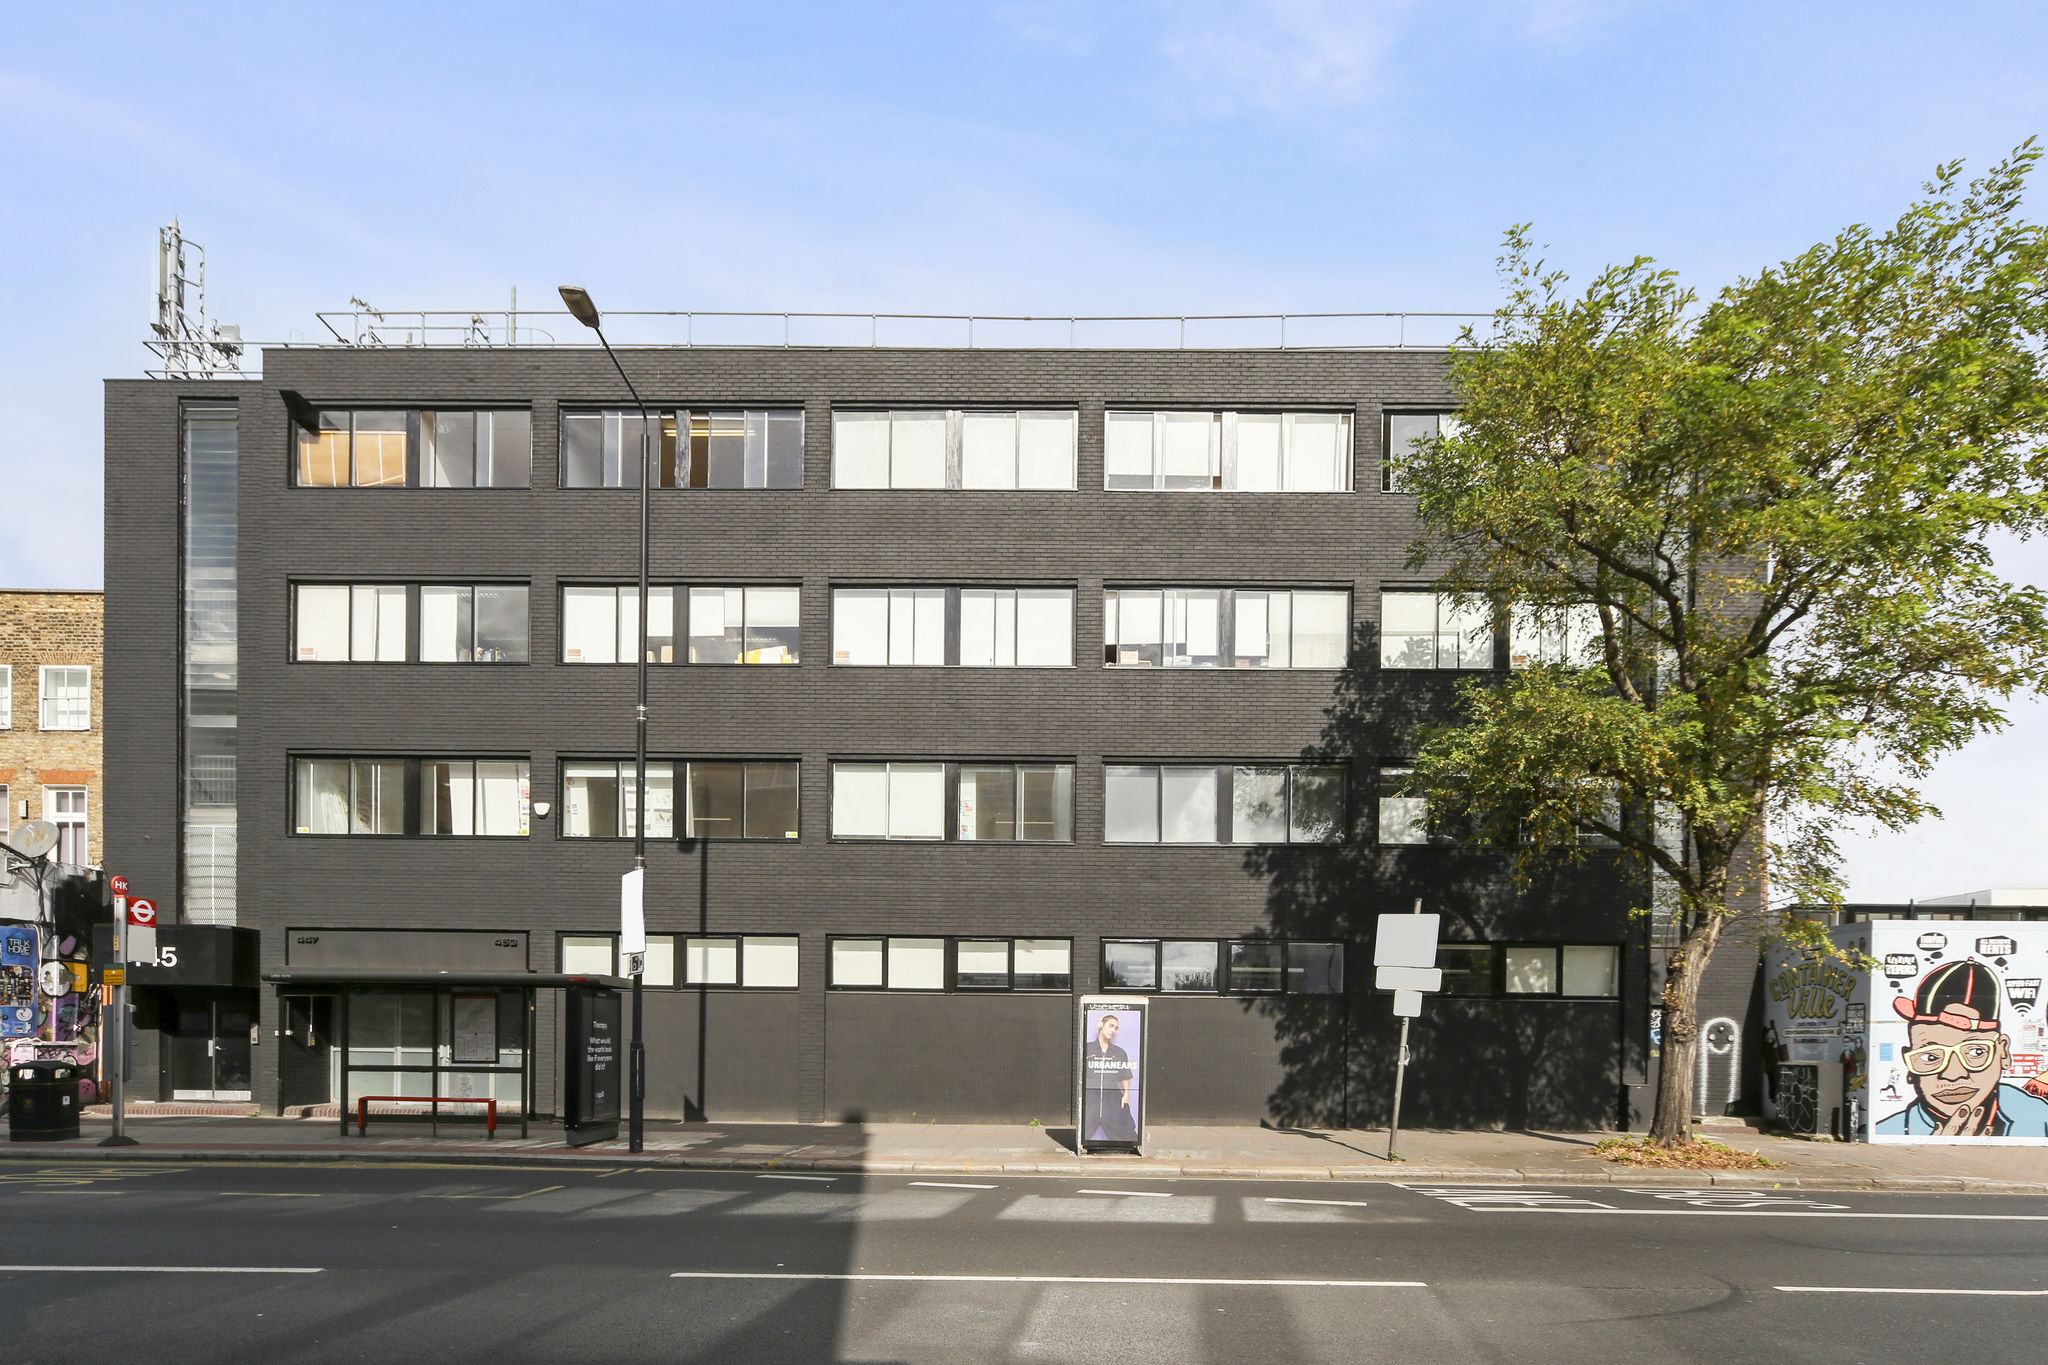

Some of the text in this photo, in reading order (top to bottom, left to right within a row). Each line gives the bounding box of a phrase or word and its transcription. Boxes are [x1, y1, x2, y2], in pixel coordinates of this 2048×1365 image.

[115, 880, 128, 890] HK
[297, 936, 319, 944] 447
[495, 938, 518, 947] 453
[1769, 963, 1857, 1002] CONTAINER
[1780, 986, 1838, 1019] Ville
[1088, 1061, 1138, 1070] URBANEARS
[1388, 1182, 1620, 1209] LANE
[1617, 1188, 1851, 1209] BUS
